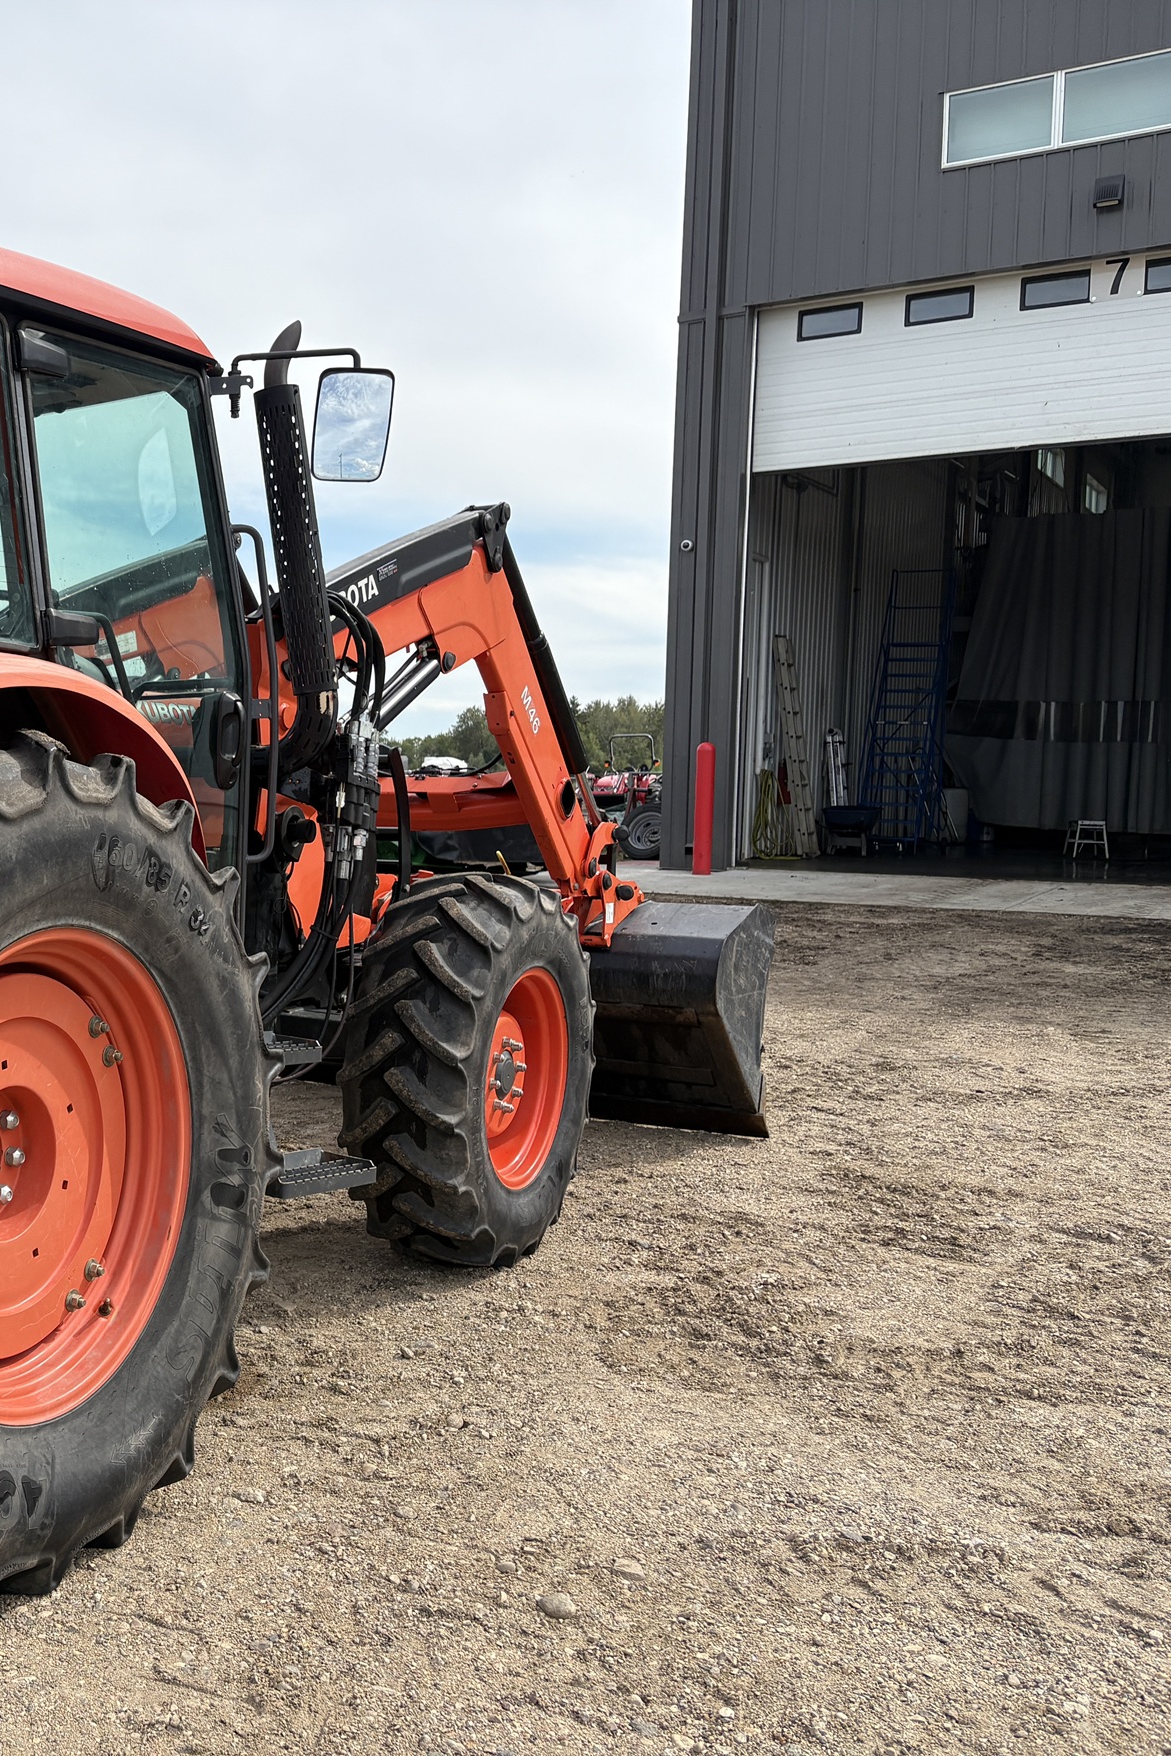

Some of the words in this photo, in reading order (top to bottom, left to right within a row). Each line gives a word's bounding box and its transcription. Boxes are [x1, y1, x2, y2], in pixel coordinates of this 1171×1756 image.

[1106, 257, 1130, 295] 7
[338, 574, 379, 608] OTA
[521, 685, 540, 734] M46
[174, 880, 191, 914] R
